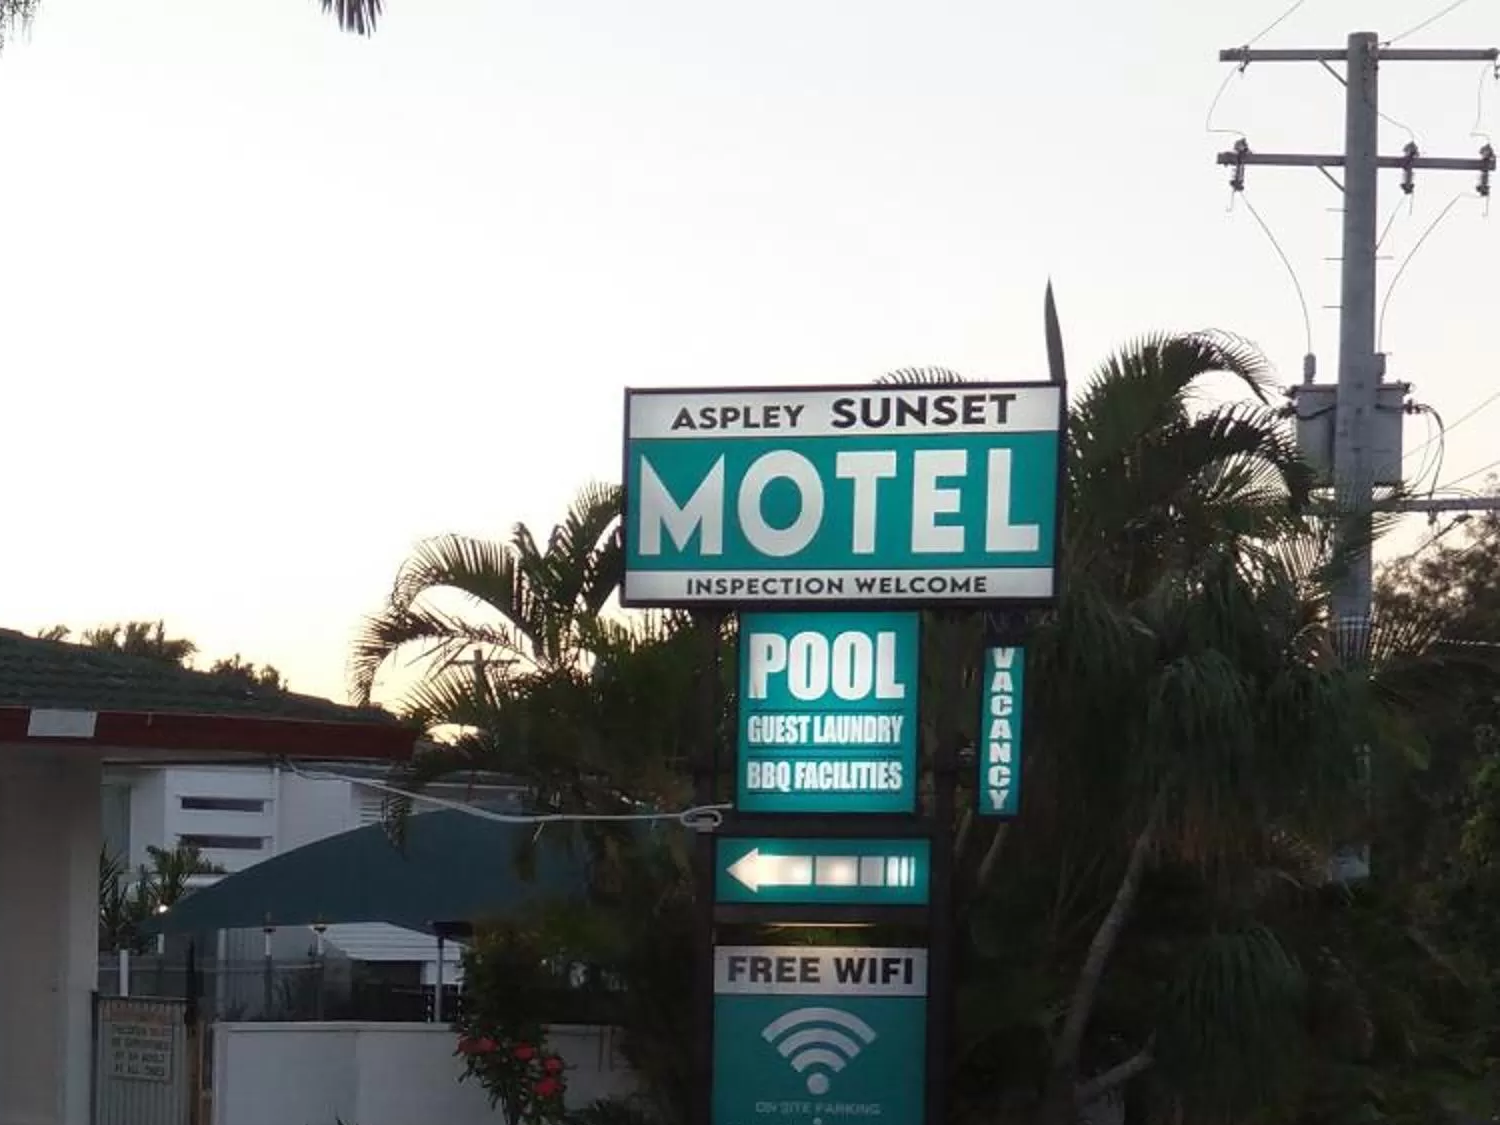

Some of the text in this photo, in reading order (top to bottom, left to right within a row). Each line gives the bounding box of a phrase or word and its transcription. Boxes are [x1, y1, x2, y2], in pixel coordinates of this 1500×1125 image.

[671, 392, 1017, 431] ASPLEY SUNSET
[638, 447, 1040, 558] MOTEL
[685, 575, 988, 596] INSPECTION WELCOME
[747, 630, 906, 701] POOL
[747, 714, 904, 745] GUEST LAUNDRY
[987, 647, 1016, 810] VACANCY
[746, 760, 903, 791] BBQ FACILITIES
[727, 956, 914, 985] FREE WIFI
